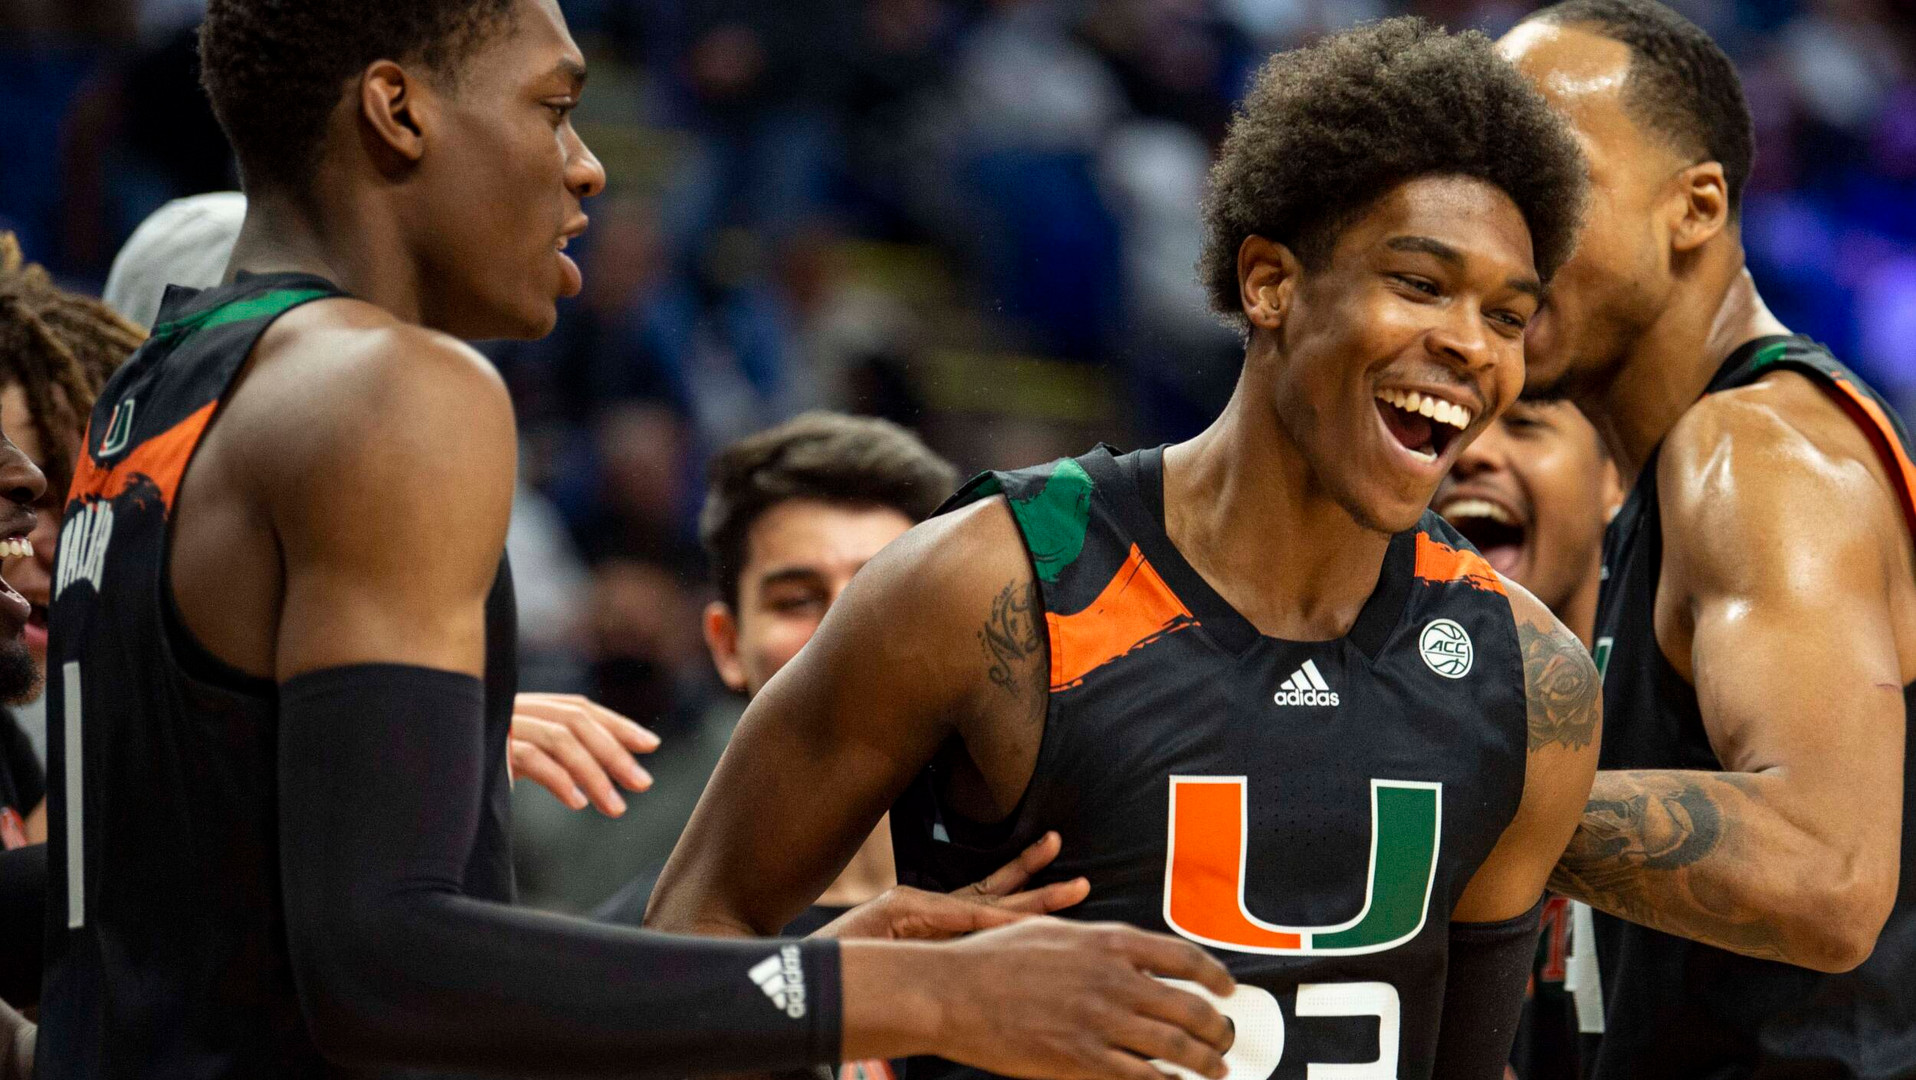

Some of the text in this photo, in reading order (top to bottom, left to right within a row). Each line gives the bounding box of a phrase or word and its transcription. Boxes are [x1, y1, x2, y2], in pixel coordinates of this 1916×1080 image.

[1429, 640, 1467, 655] ACC
[1273, 688, 1340, 707] adidas
[1163, 775, 1443, 957] U
[781, 944, 806, 1019] adidas
